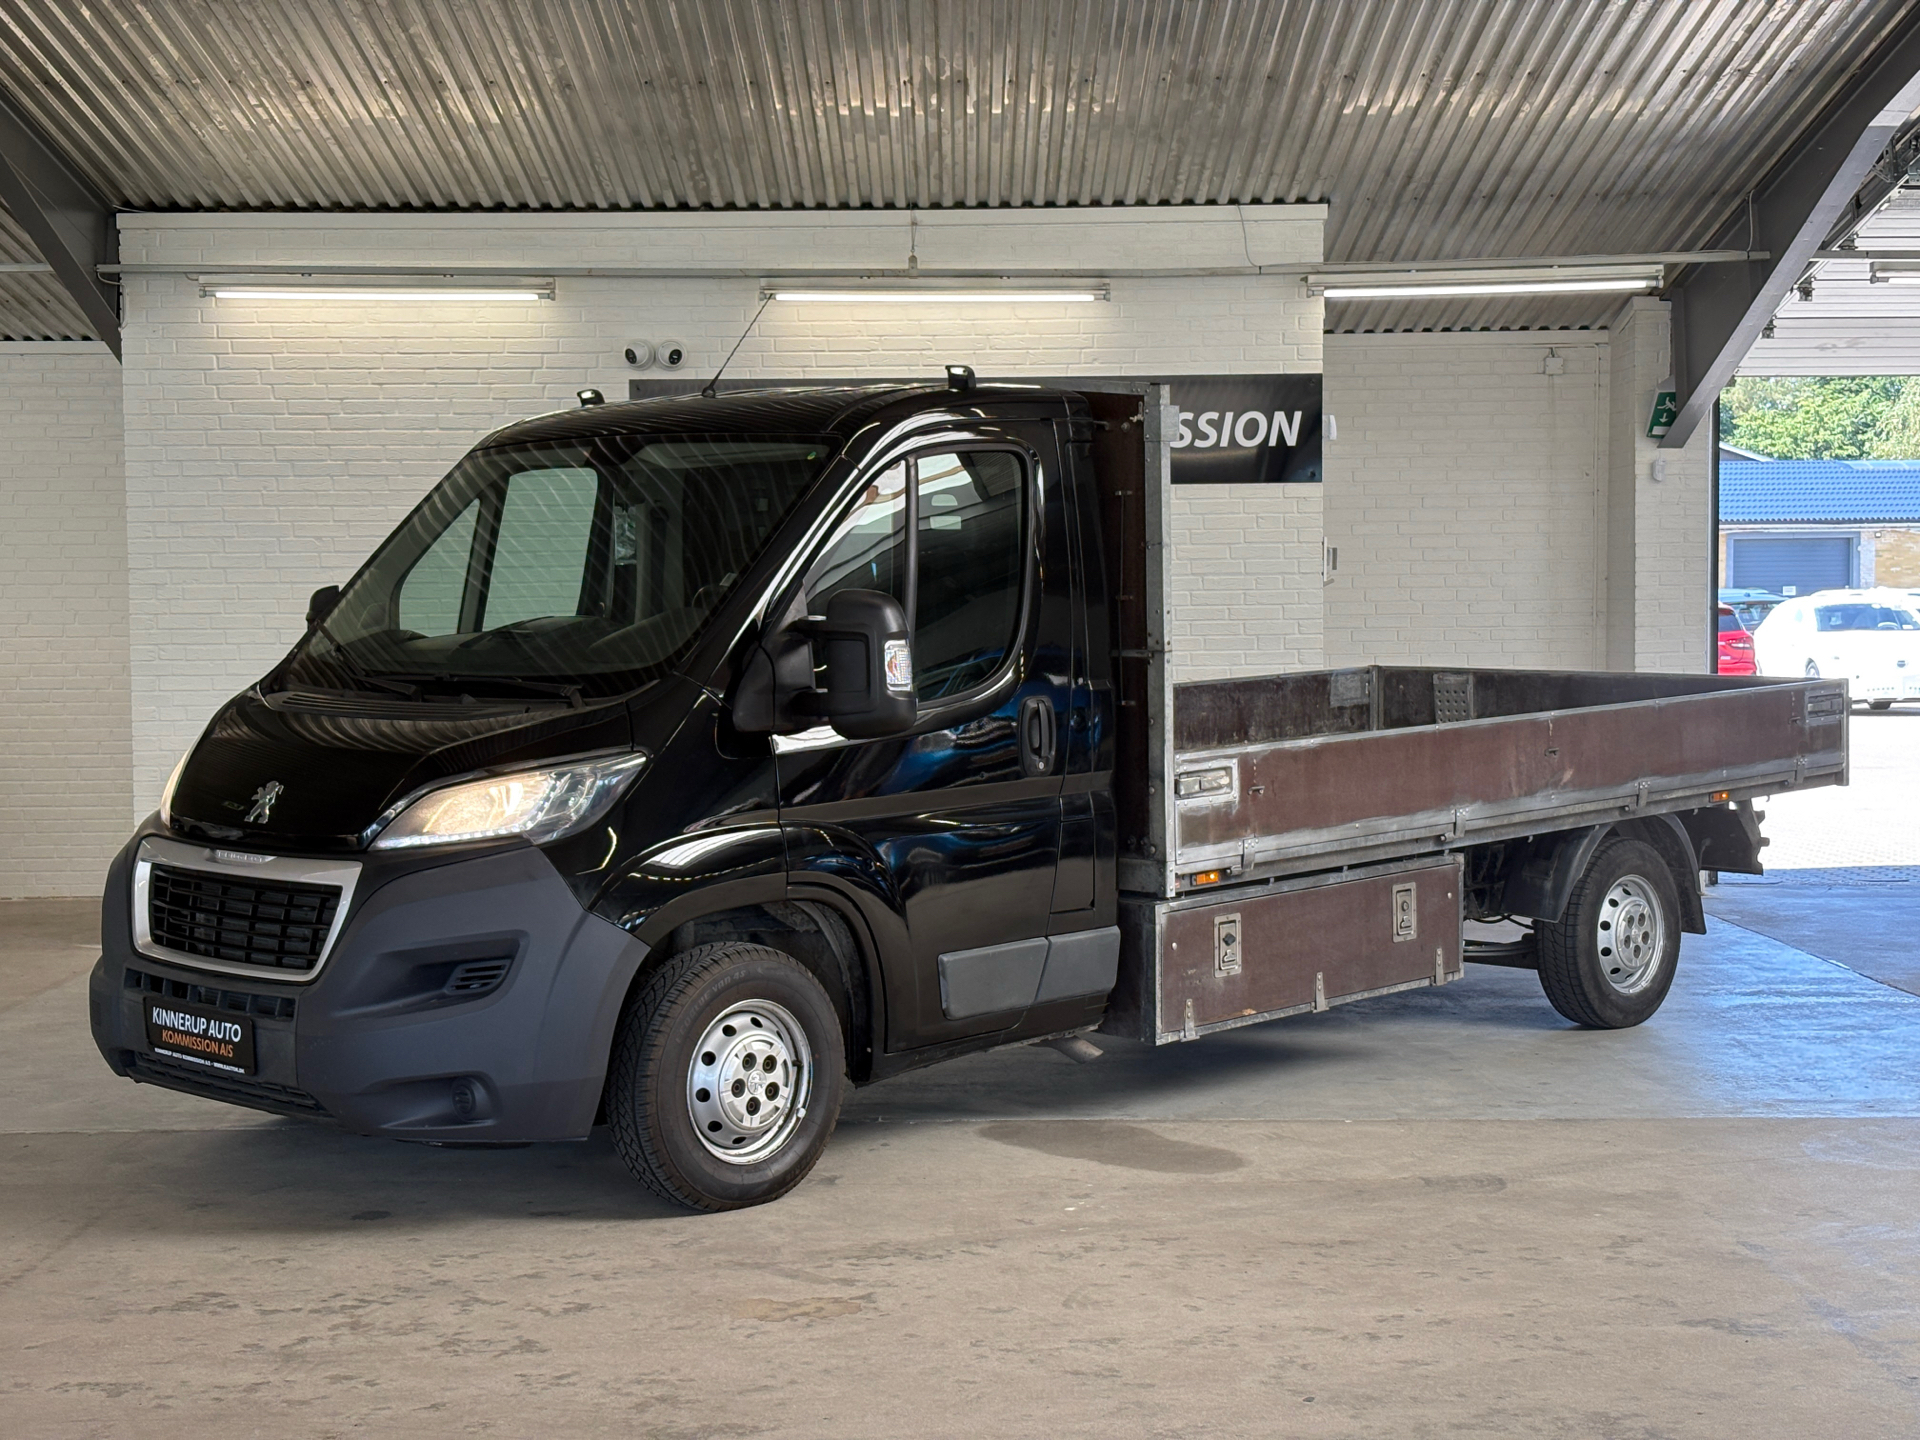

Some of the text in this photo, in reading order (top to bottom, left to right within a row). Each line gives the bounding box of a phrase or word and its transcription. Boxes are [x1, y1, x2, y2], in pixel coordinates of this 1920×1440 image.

[152, 1006, 242, 1042] KINNERUP AUTO
[162, 1029, 234, 1058] KOMMISSION A/S
